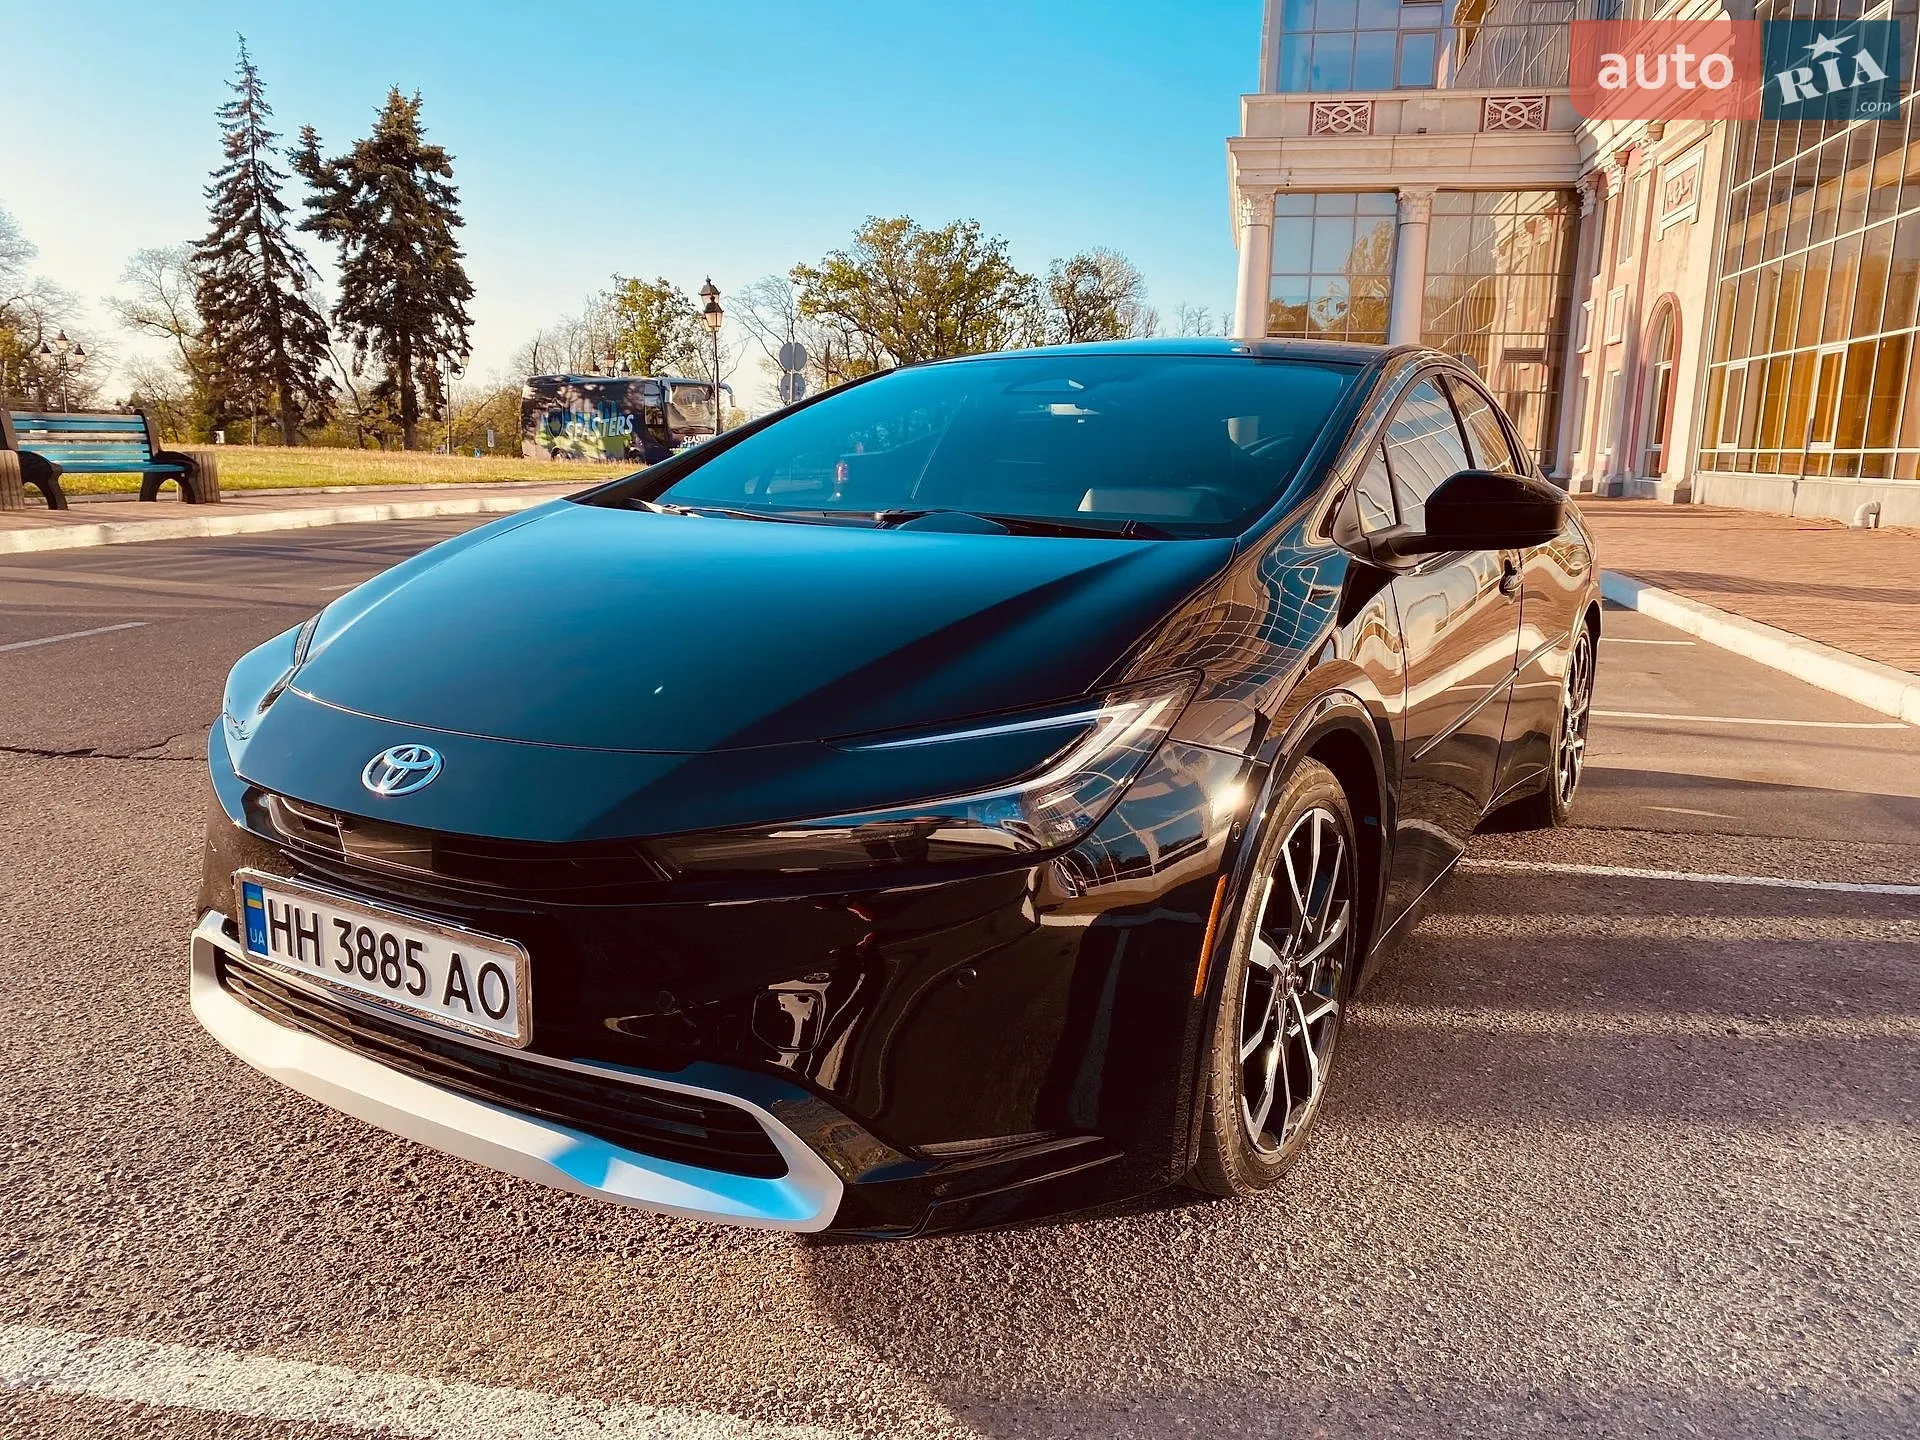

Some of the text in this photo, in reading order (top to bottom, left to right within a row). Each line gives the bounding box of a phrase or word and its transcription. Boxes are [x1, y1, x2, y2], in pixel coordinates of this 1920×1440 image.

[565, 413, 634, 439] SEASTERS
[682, 434, 711, 445] SEASTE
[249, 927, 266, 947] UA
[267, 898, 510, 1020] HH 3885 AO
